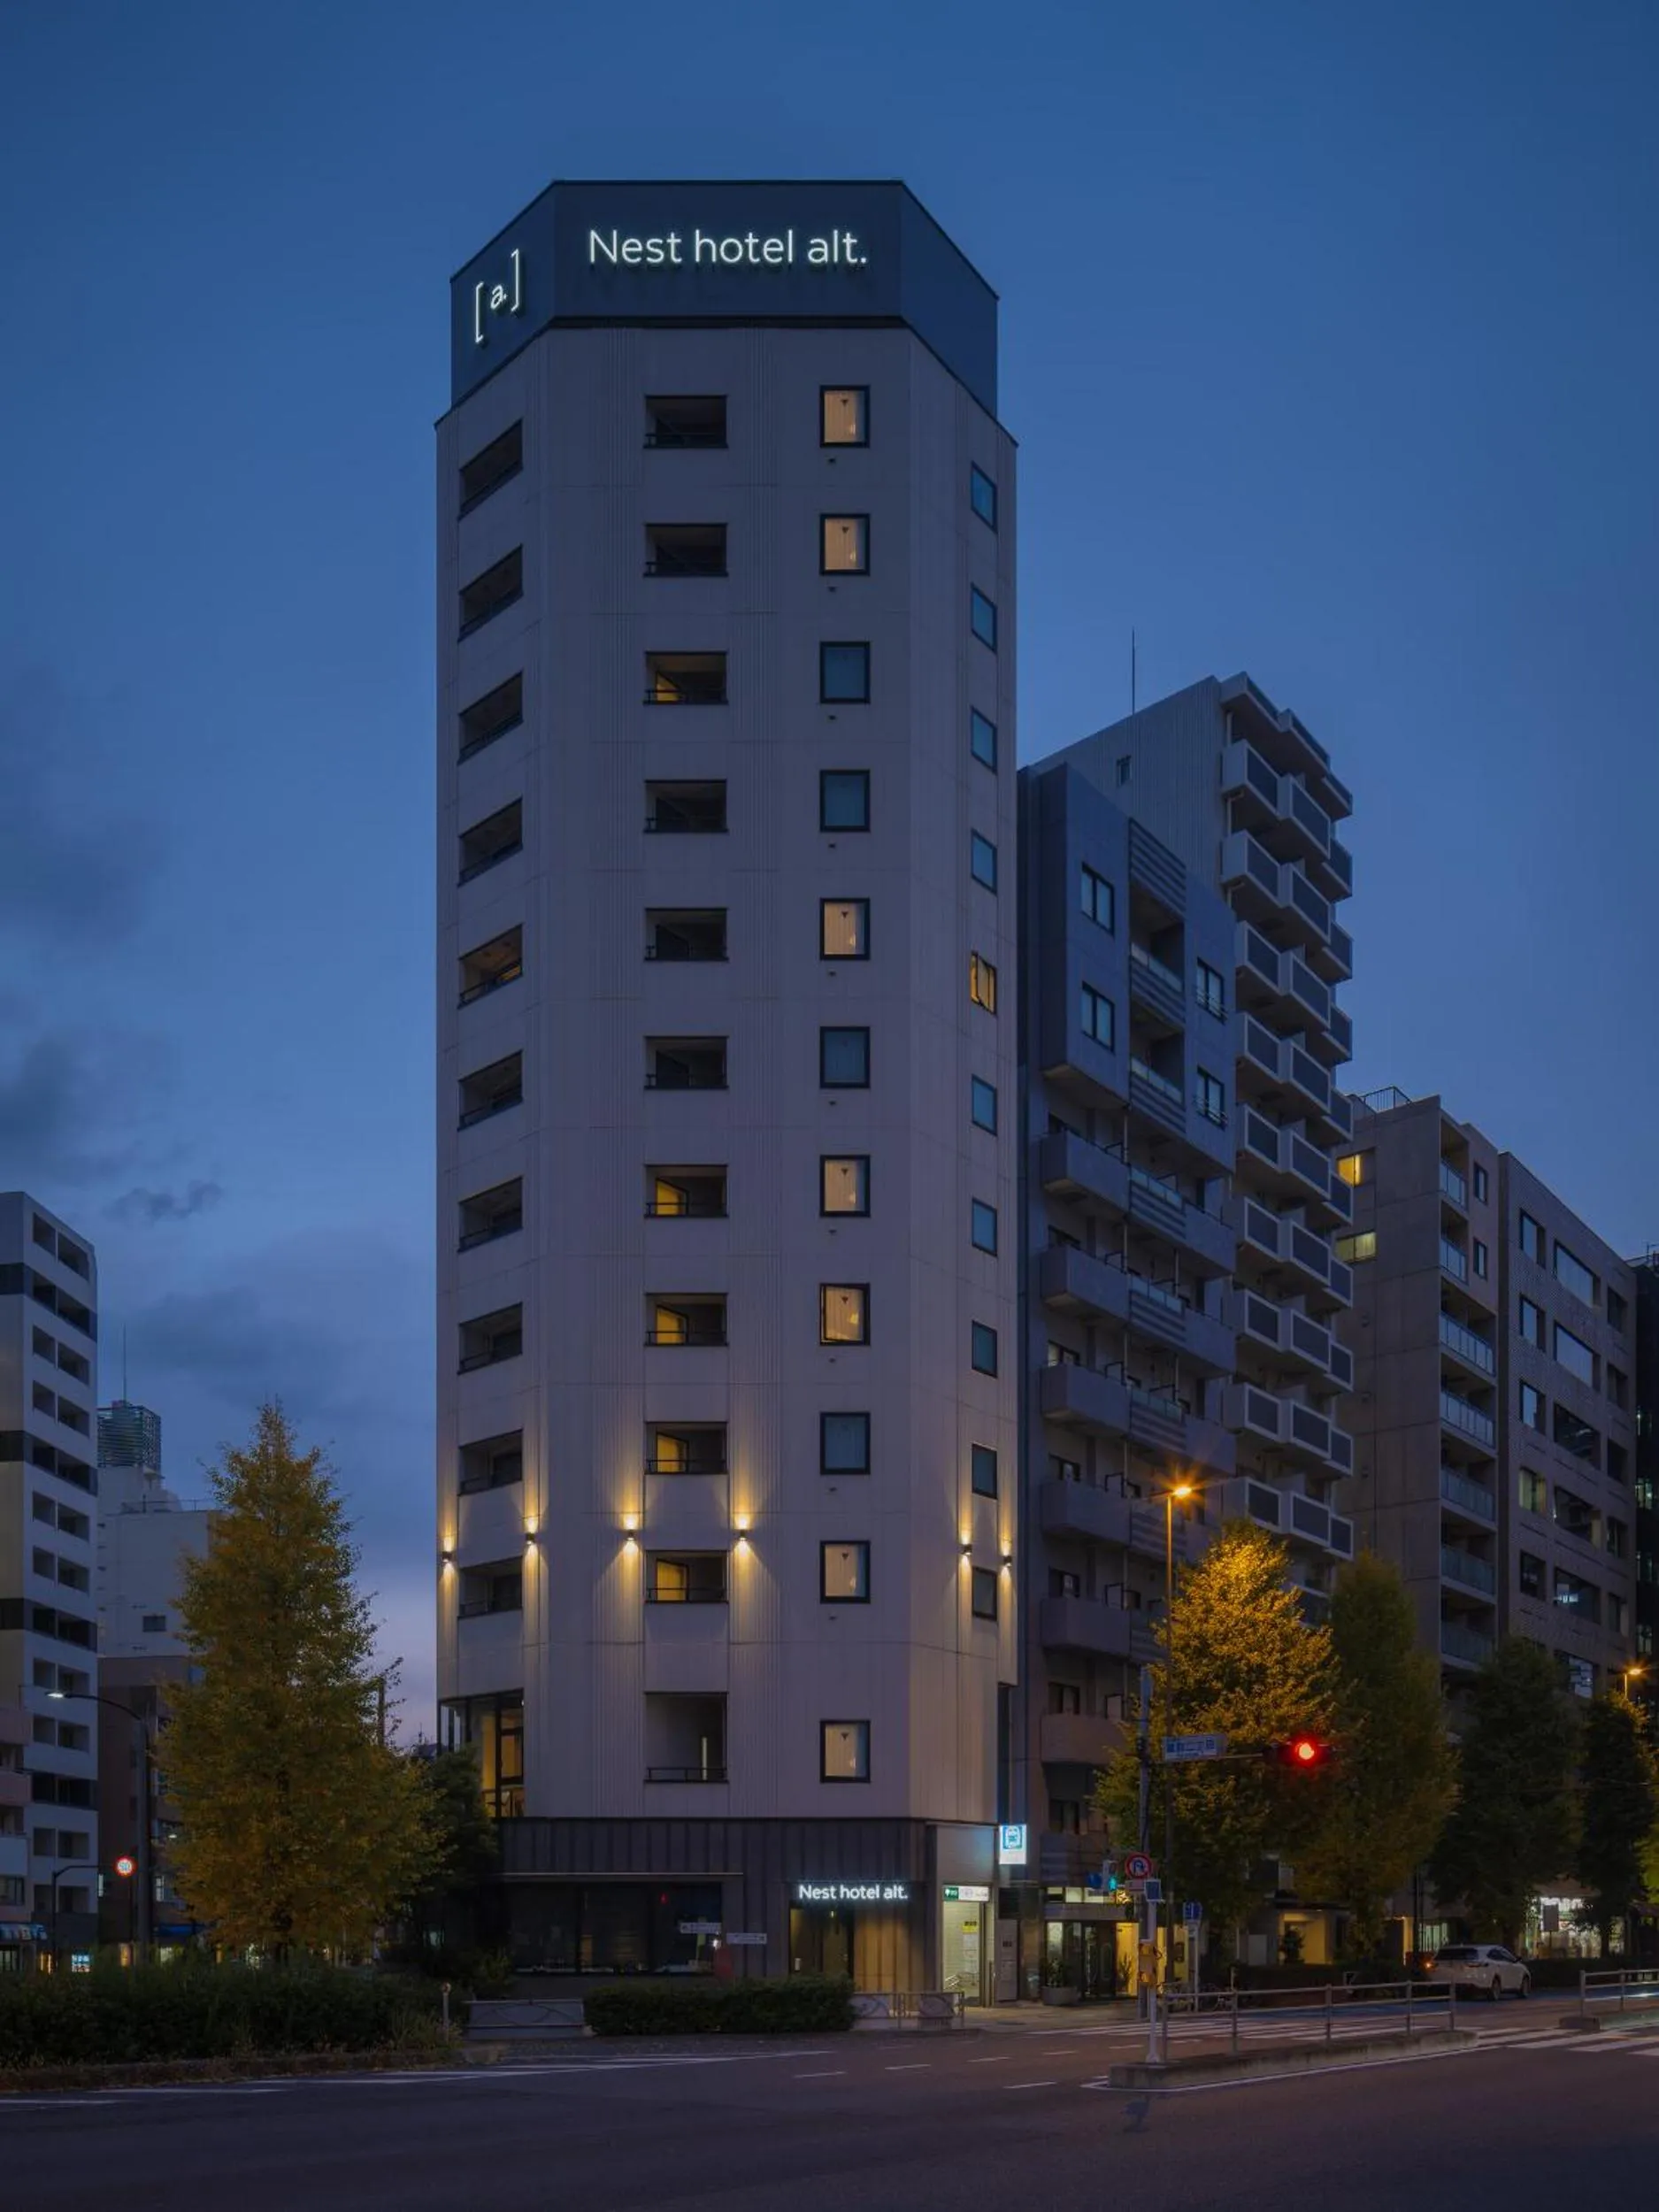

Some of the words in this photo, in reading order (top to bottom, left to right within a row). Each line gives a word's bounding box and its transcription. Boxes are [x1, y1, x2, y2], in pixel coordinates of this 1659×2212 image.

[589, 228, 682, 265] Nest
[695, 228, 794, 265] hotel
[807, 228, 867, 265] alt.
[798, 1884, 837, 1901] Nest
[839, 1884, 880, 1901] hotel
[882, 1884, 909, 1901] alt.
